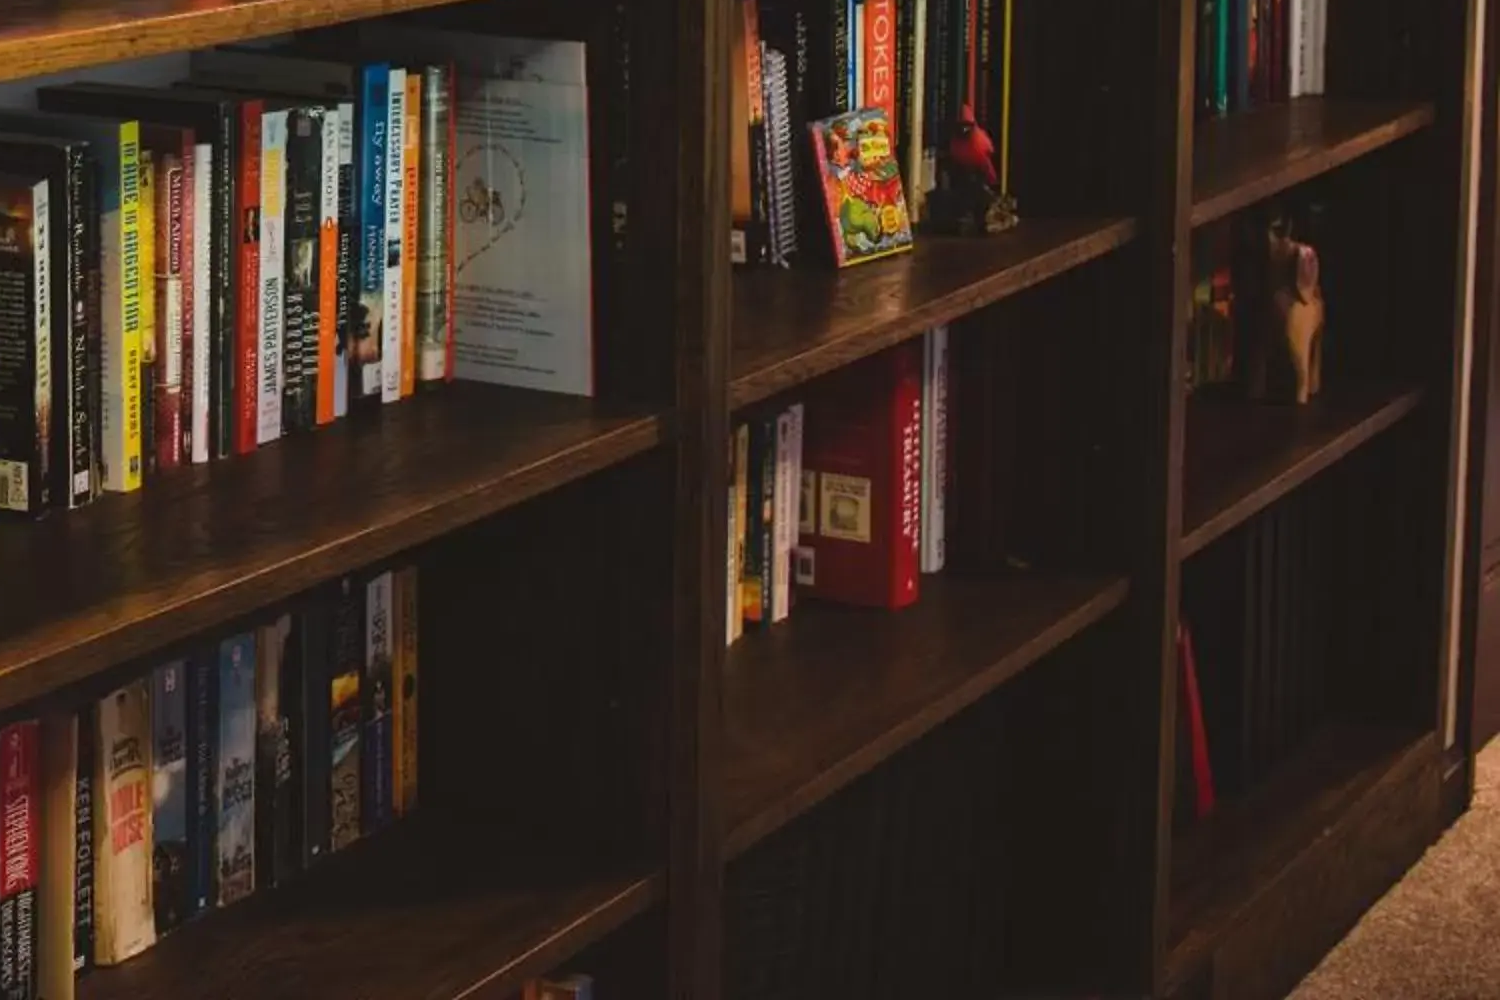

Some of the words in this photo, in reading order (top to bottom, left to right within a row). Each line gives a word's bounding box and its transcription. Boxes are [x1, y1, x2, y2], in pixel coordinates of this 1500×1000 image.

[372, 153, 386, 207] away
[367, 224, 379, 291] HANNAH
[262, 277, 280, 349] PATTERSON
[74, 334, 87, 407] Nicholas
[262, 351, 279, 394] JAMES
[902, 423, 914, 538] TREASURY
[3, 794, 29, 853] STEPHEN
[76, 776, 91, 825] KEN
[3, 853, 31, 891] KING
[77, 829, 93, 928] FOLLETT
